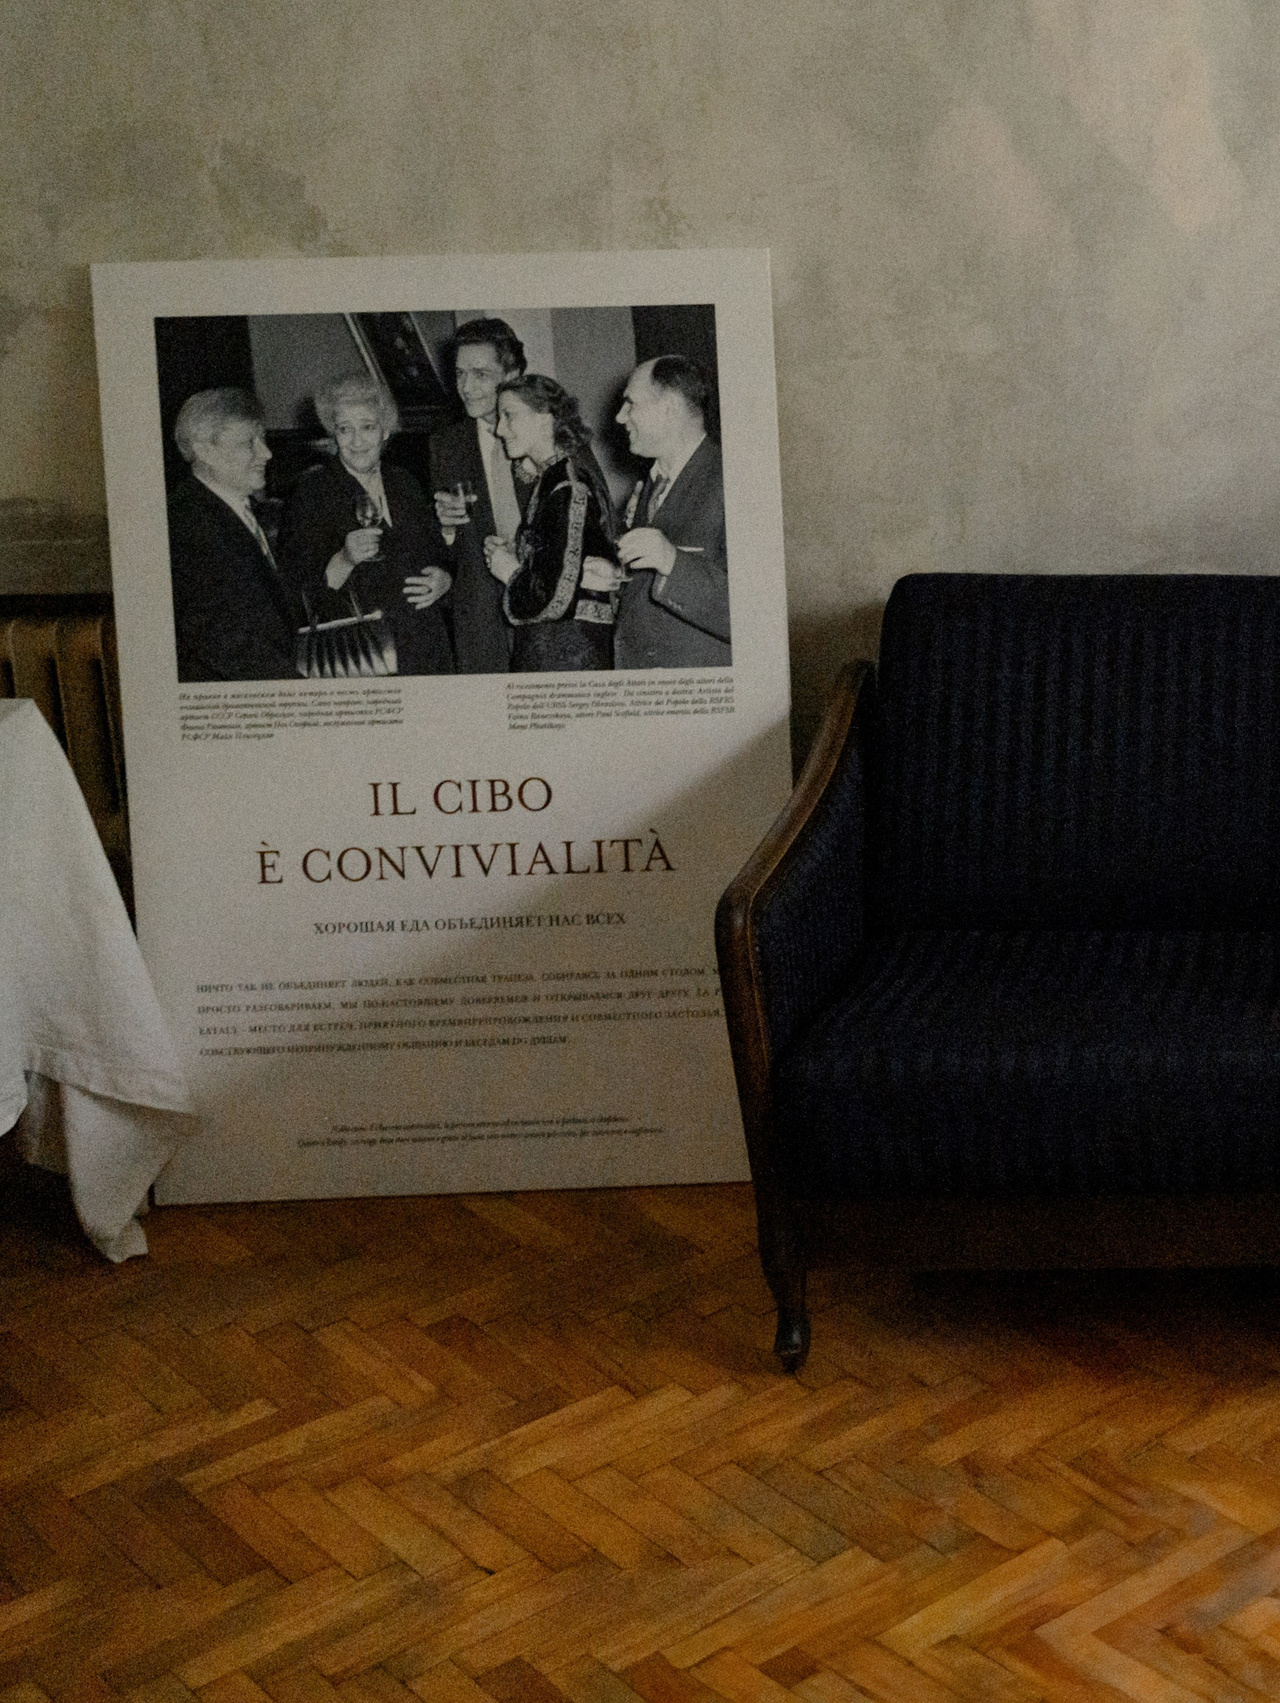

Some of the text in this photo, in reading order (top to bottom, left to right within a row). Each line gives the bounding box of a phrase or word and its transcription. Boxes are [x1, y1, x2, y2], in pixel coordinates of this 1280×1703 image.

[369, 777, 553, 817] IL CIBO
[257, 828, 675, 885] È CONVIVIALITÀ
[312, 911, 626, 934] ХОРОШАЯ ЕДА ОБЪЕДИНЯЕТ НАС ВСЕХ
